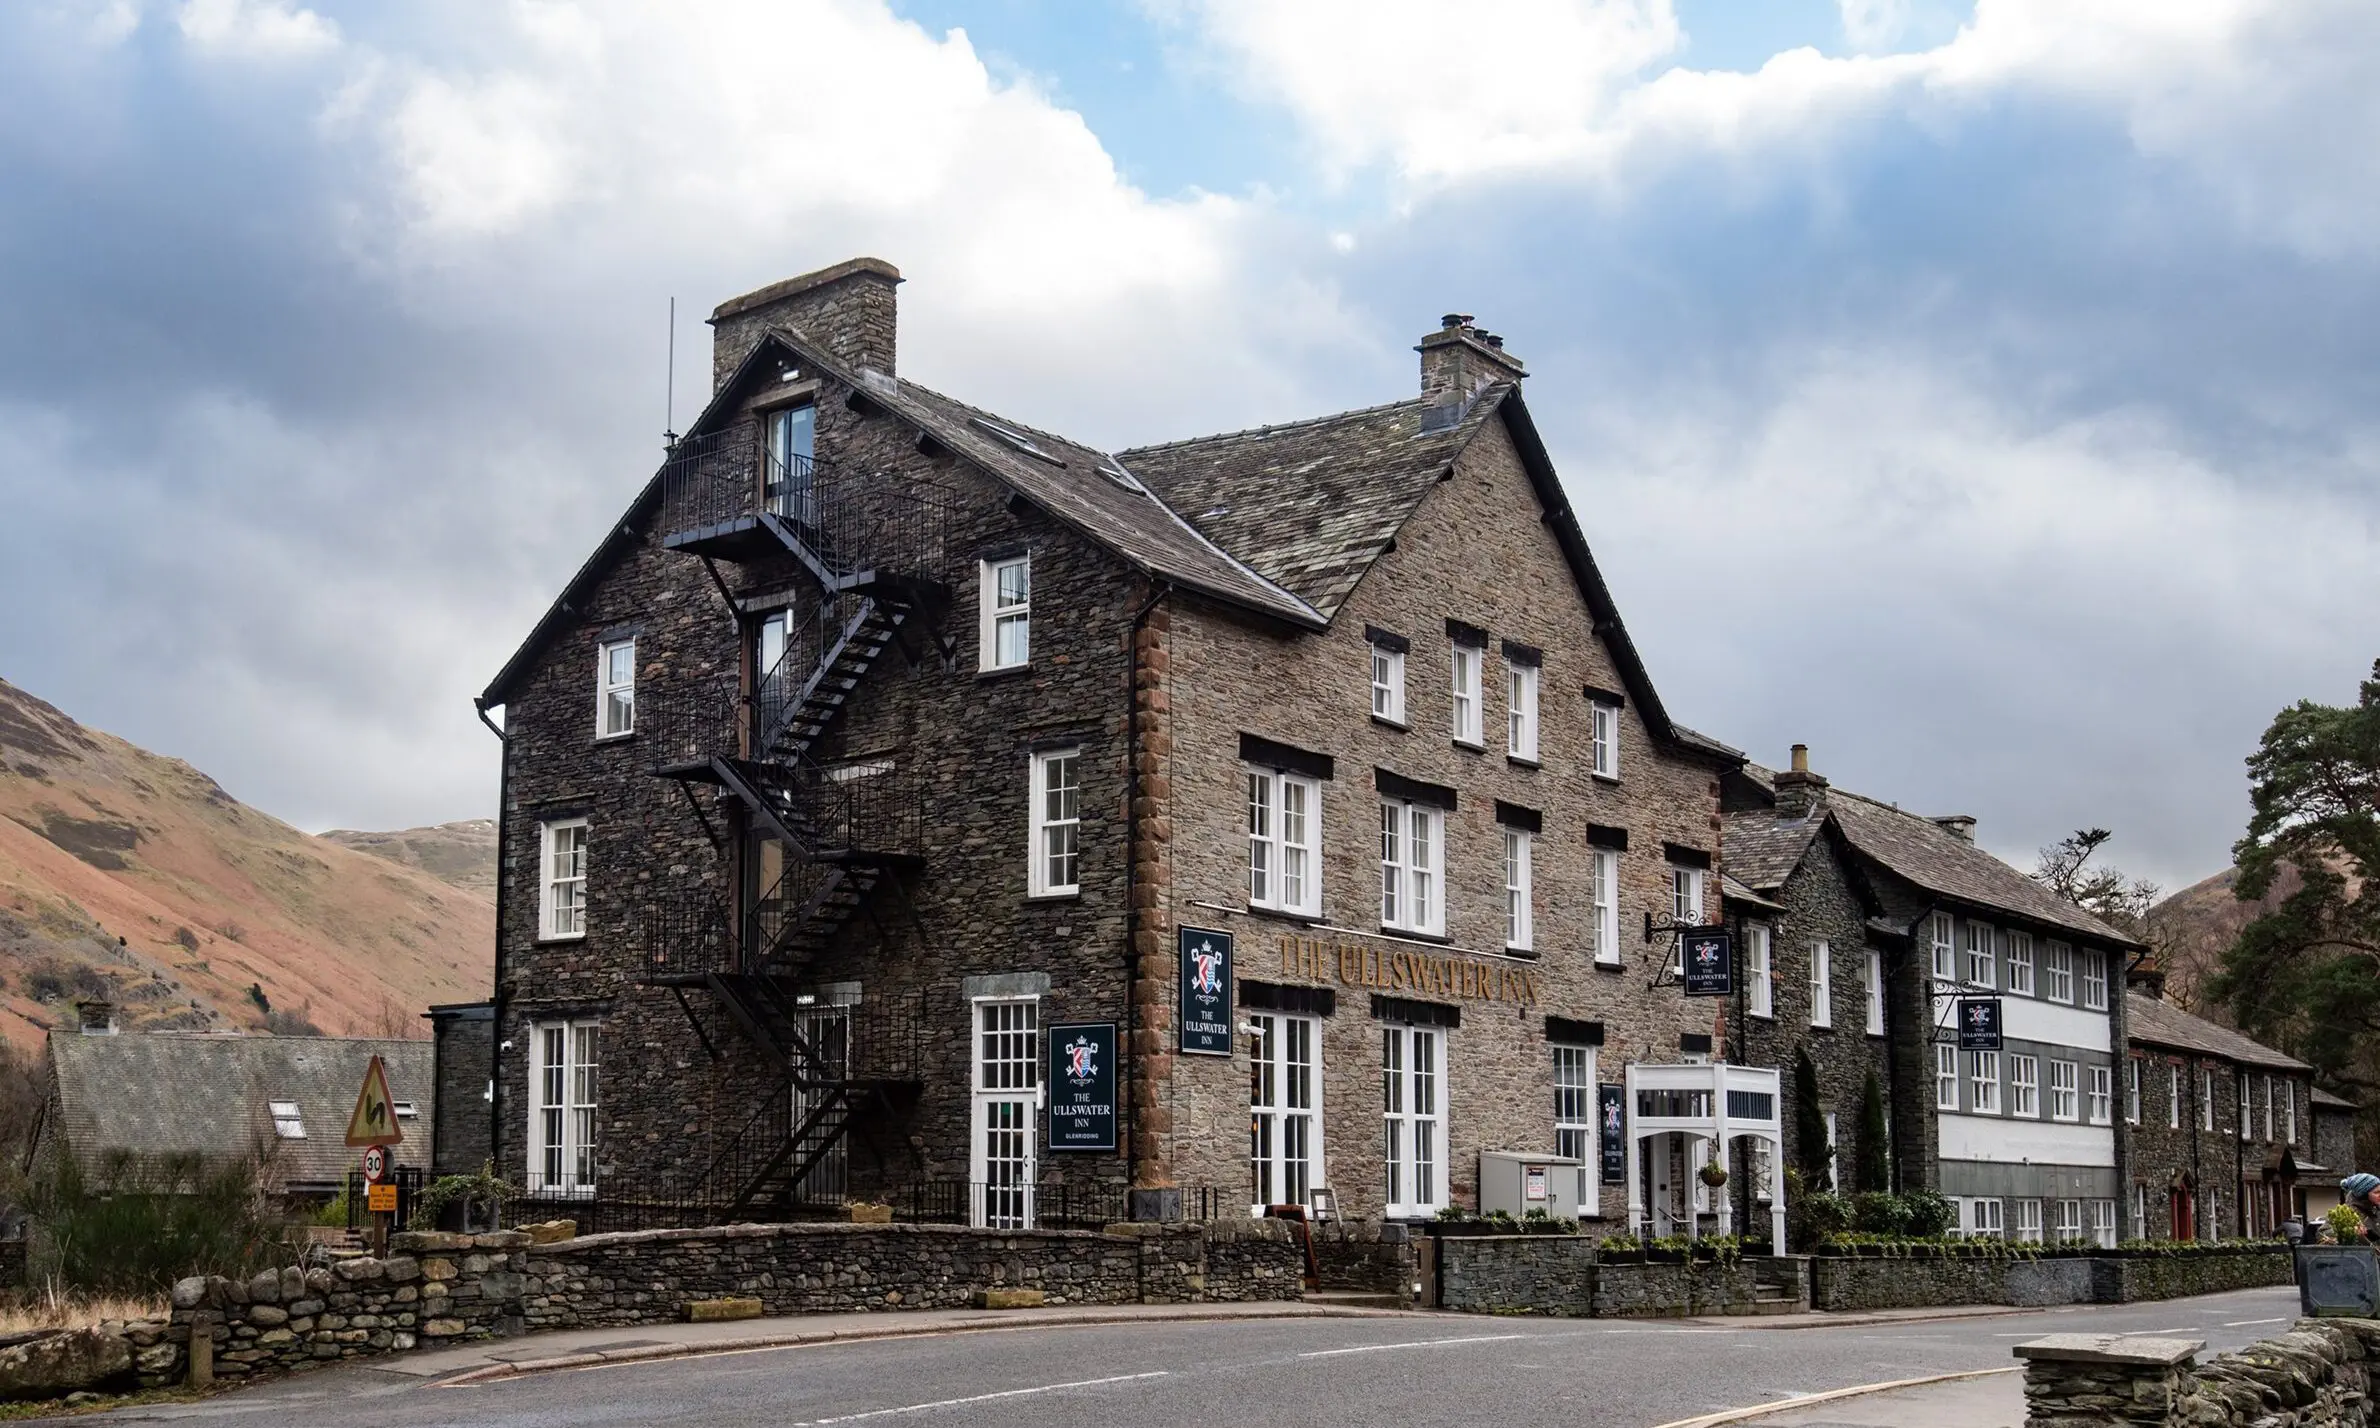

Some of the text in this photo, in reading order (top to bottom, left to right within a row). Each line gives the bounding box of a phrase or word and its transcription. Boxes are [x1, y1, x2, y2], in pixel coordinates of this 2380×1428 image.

[1277, 934, 1538, 1004] THE ULLSWATER INN
[1201, 1011, 1213, 1020] THE
[1185, 1021, 1228, 1035] ULLSWATER
[1201, 1036, 1212, 1045] INN
[1073, 1093, 1090, 1102] THE
[1053, 1104, 1110, 1116] ULLSWATER
[1074, 1118, 1089, 1127] INN
[367, 1156, 381, 1171] 30
